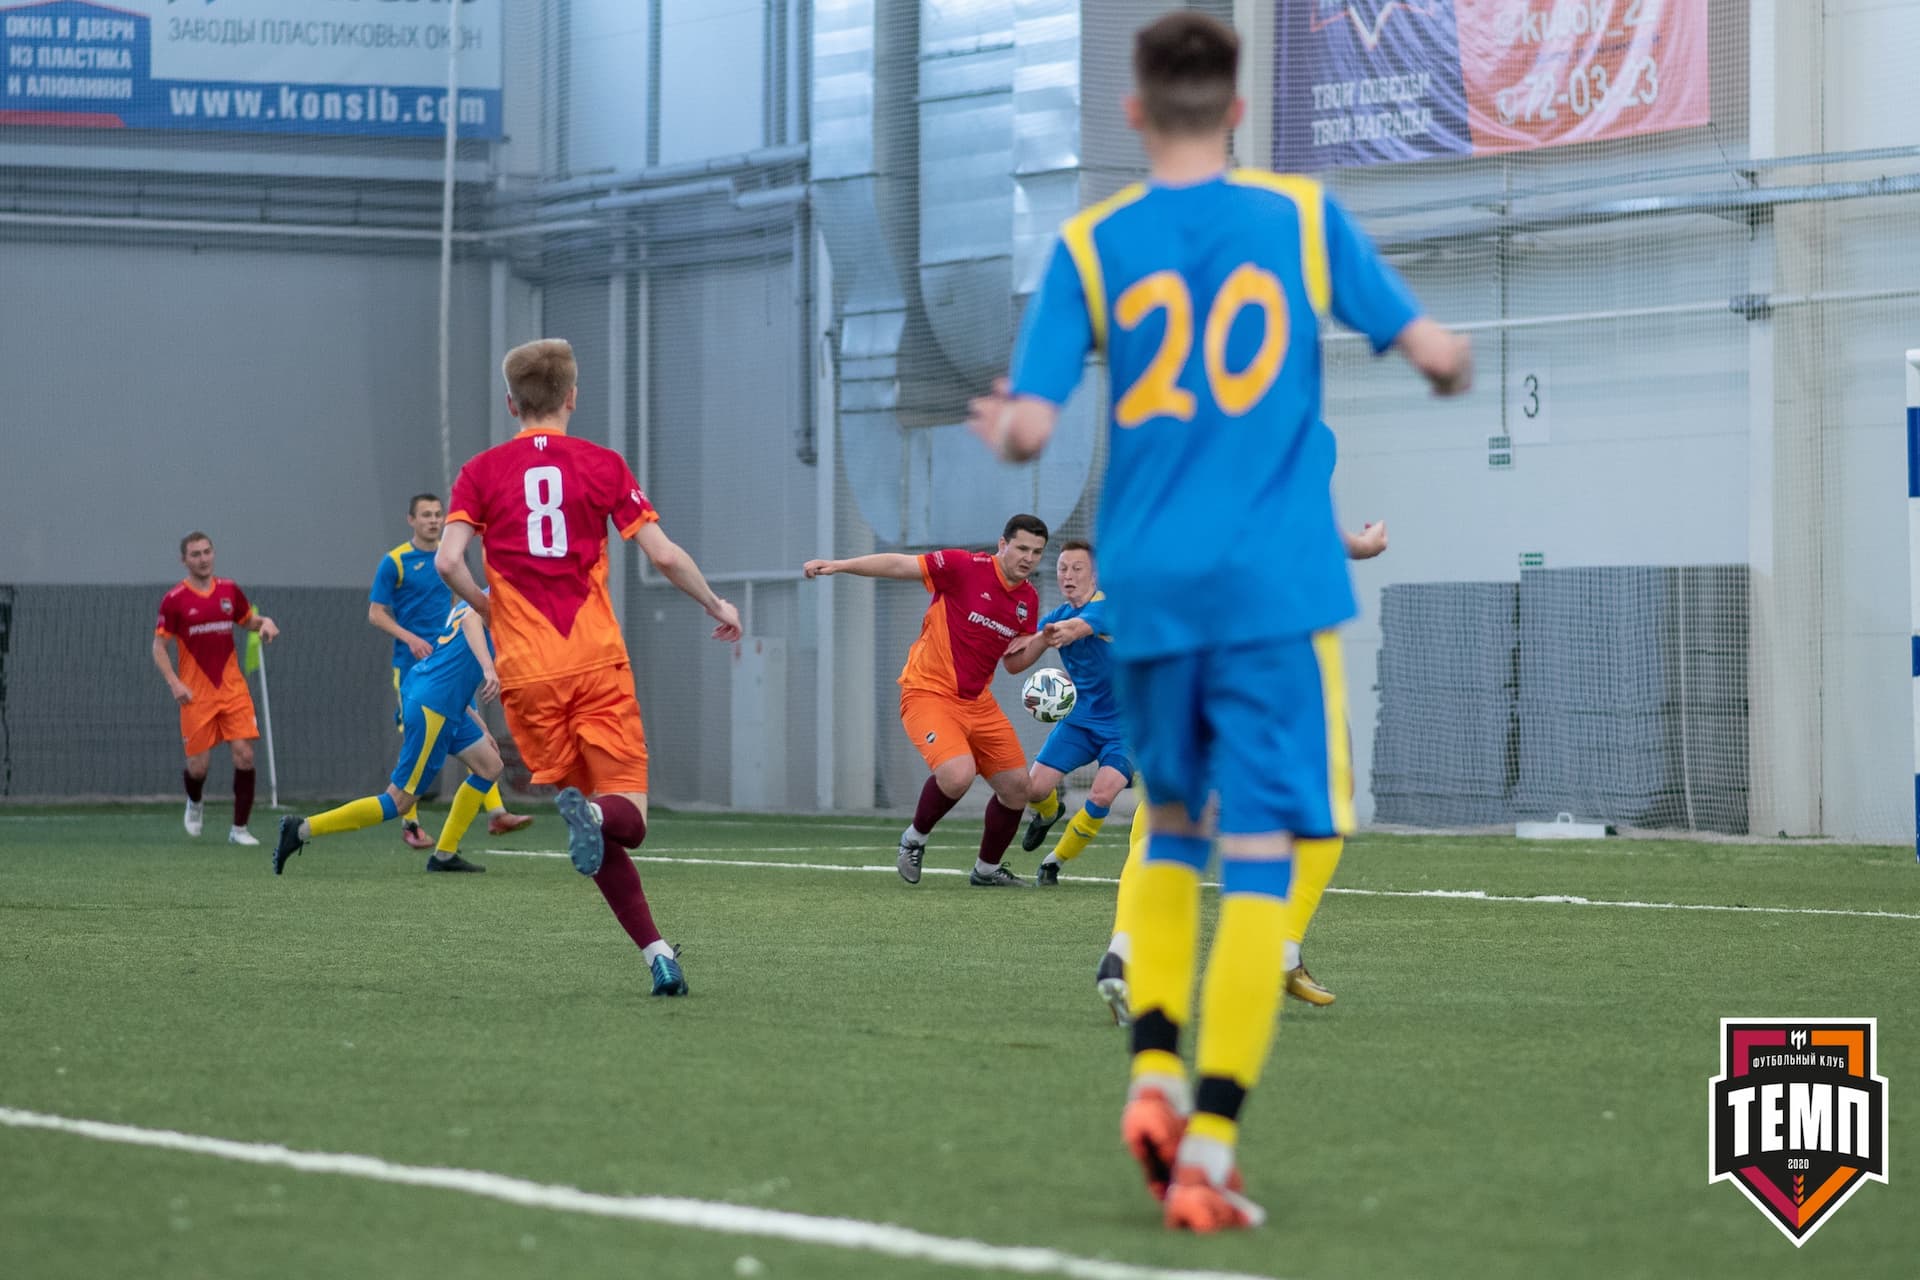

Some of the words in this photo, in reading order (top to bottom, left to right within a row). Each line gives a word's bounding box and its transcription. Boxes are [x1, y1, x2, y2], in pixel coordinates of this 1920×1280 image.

[6, 16, 53, 39] ОКНА
[57, 16, 70, 39] И
[76, 18, 135, 42] ДВЕРИ
[167, 16, 255, 45] ЗАВОДЫ
[262, 20, 419, 48] ПЛАСТИКОВЫХ
[10, 45, 33, 67] ИЗ
[37, 46, 133, 69] ПЛАСТИКА
[7, 74, 21, 96] И
[26, 75, 133, 98] АЛЮМИНИЯ
[169, 86, 486, 124] www.konsib.com
[1113, 260, 1291, 429] 20
[1523, 373, 1540, 418] 3
[524, 465, 568, 558] 8
